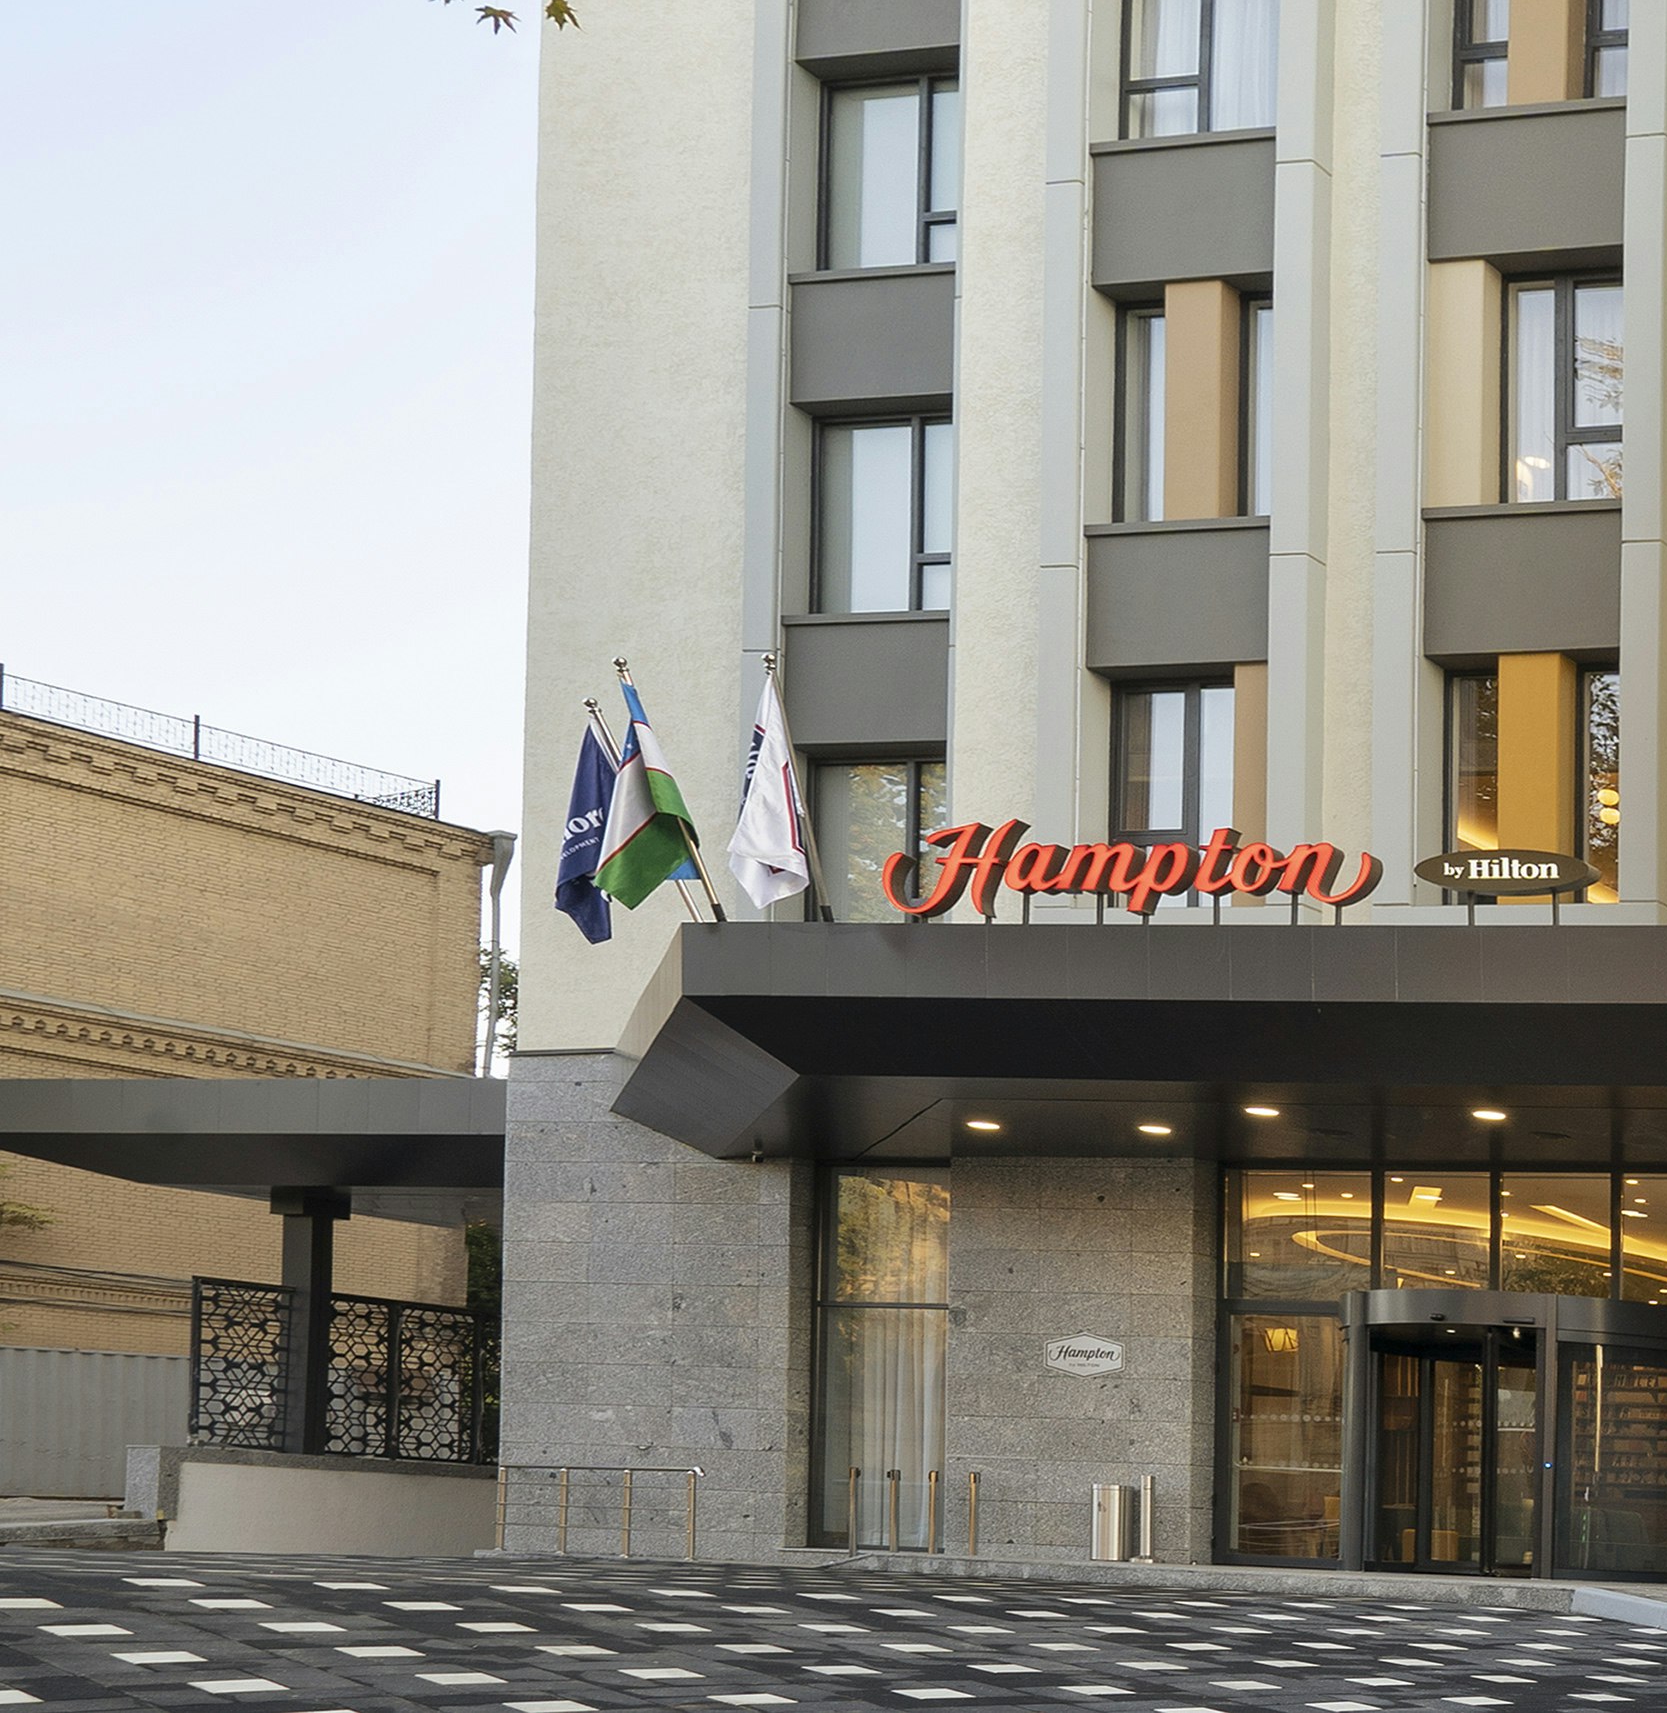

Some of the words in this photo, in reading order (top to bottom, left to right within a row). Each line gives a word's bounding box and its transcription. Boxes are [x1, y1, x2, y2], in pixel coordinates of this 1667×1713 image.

[882, 819, 1383, 919] Hampton
[1443, 862, 1465, 881] by
[1467, 858, 1560, 880] Hilton
[1049, 1345, 1120, 1361] Hampton
